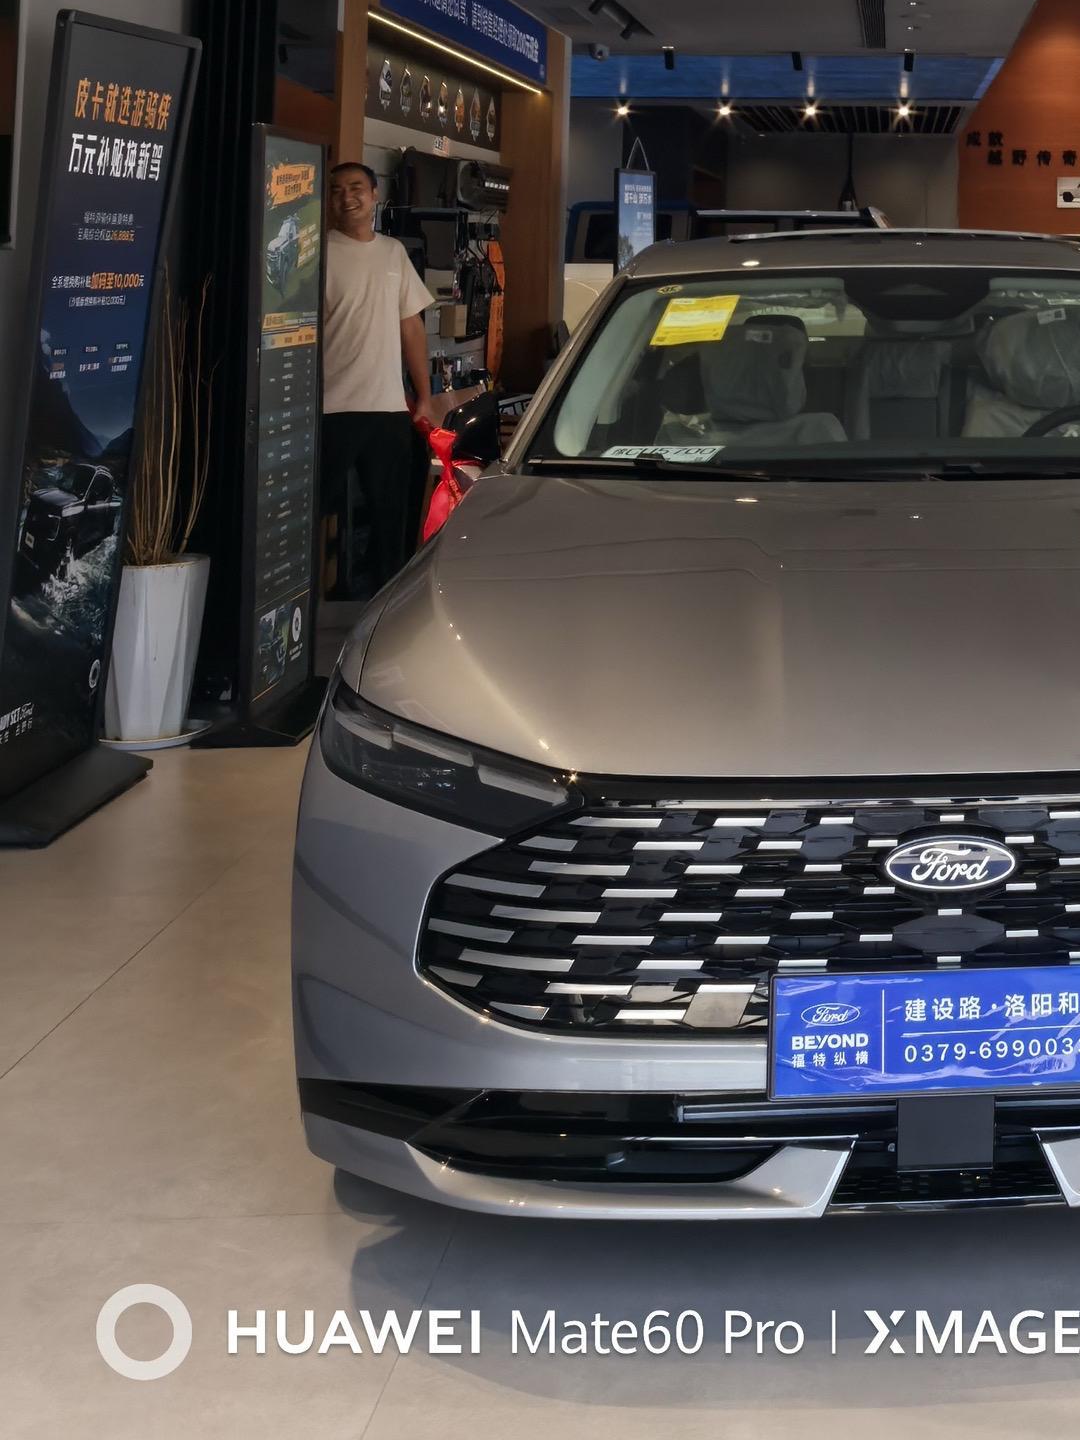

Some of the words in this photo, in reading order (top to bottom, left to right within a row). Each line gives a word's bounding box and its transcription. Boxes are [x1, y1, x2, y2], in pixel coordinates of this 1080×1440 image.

[75, 78, 171, 130] 皮卡就选游骑侠
[68, 133, 164, 181] 万元补贴换新驾
[910, 847, 991, 882] Ford
[811, 1005, 850, 1024] Ford
[791, 1033, 869, 1051] BEYOND
[791, 1050, 869, 1068] 福特纵横
